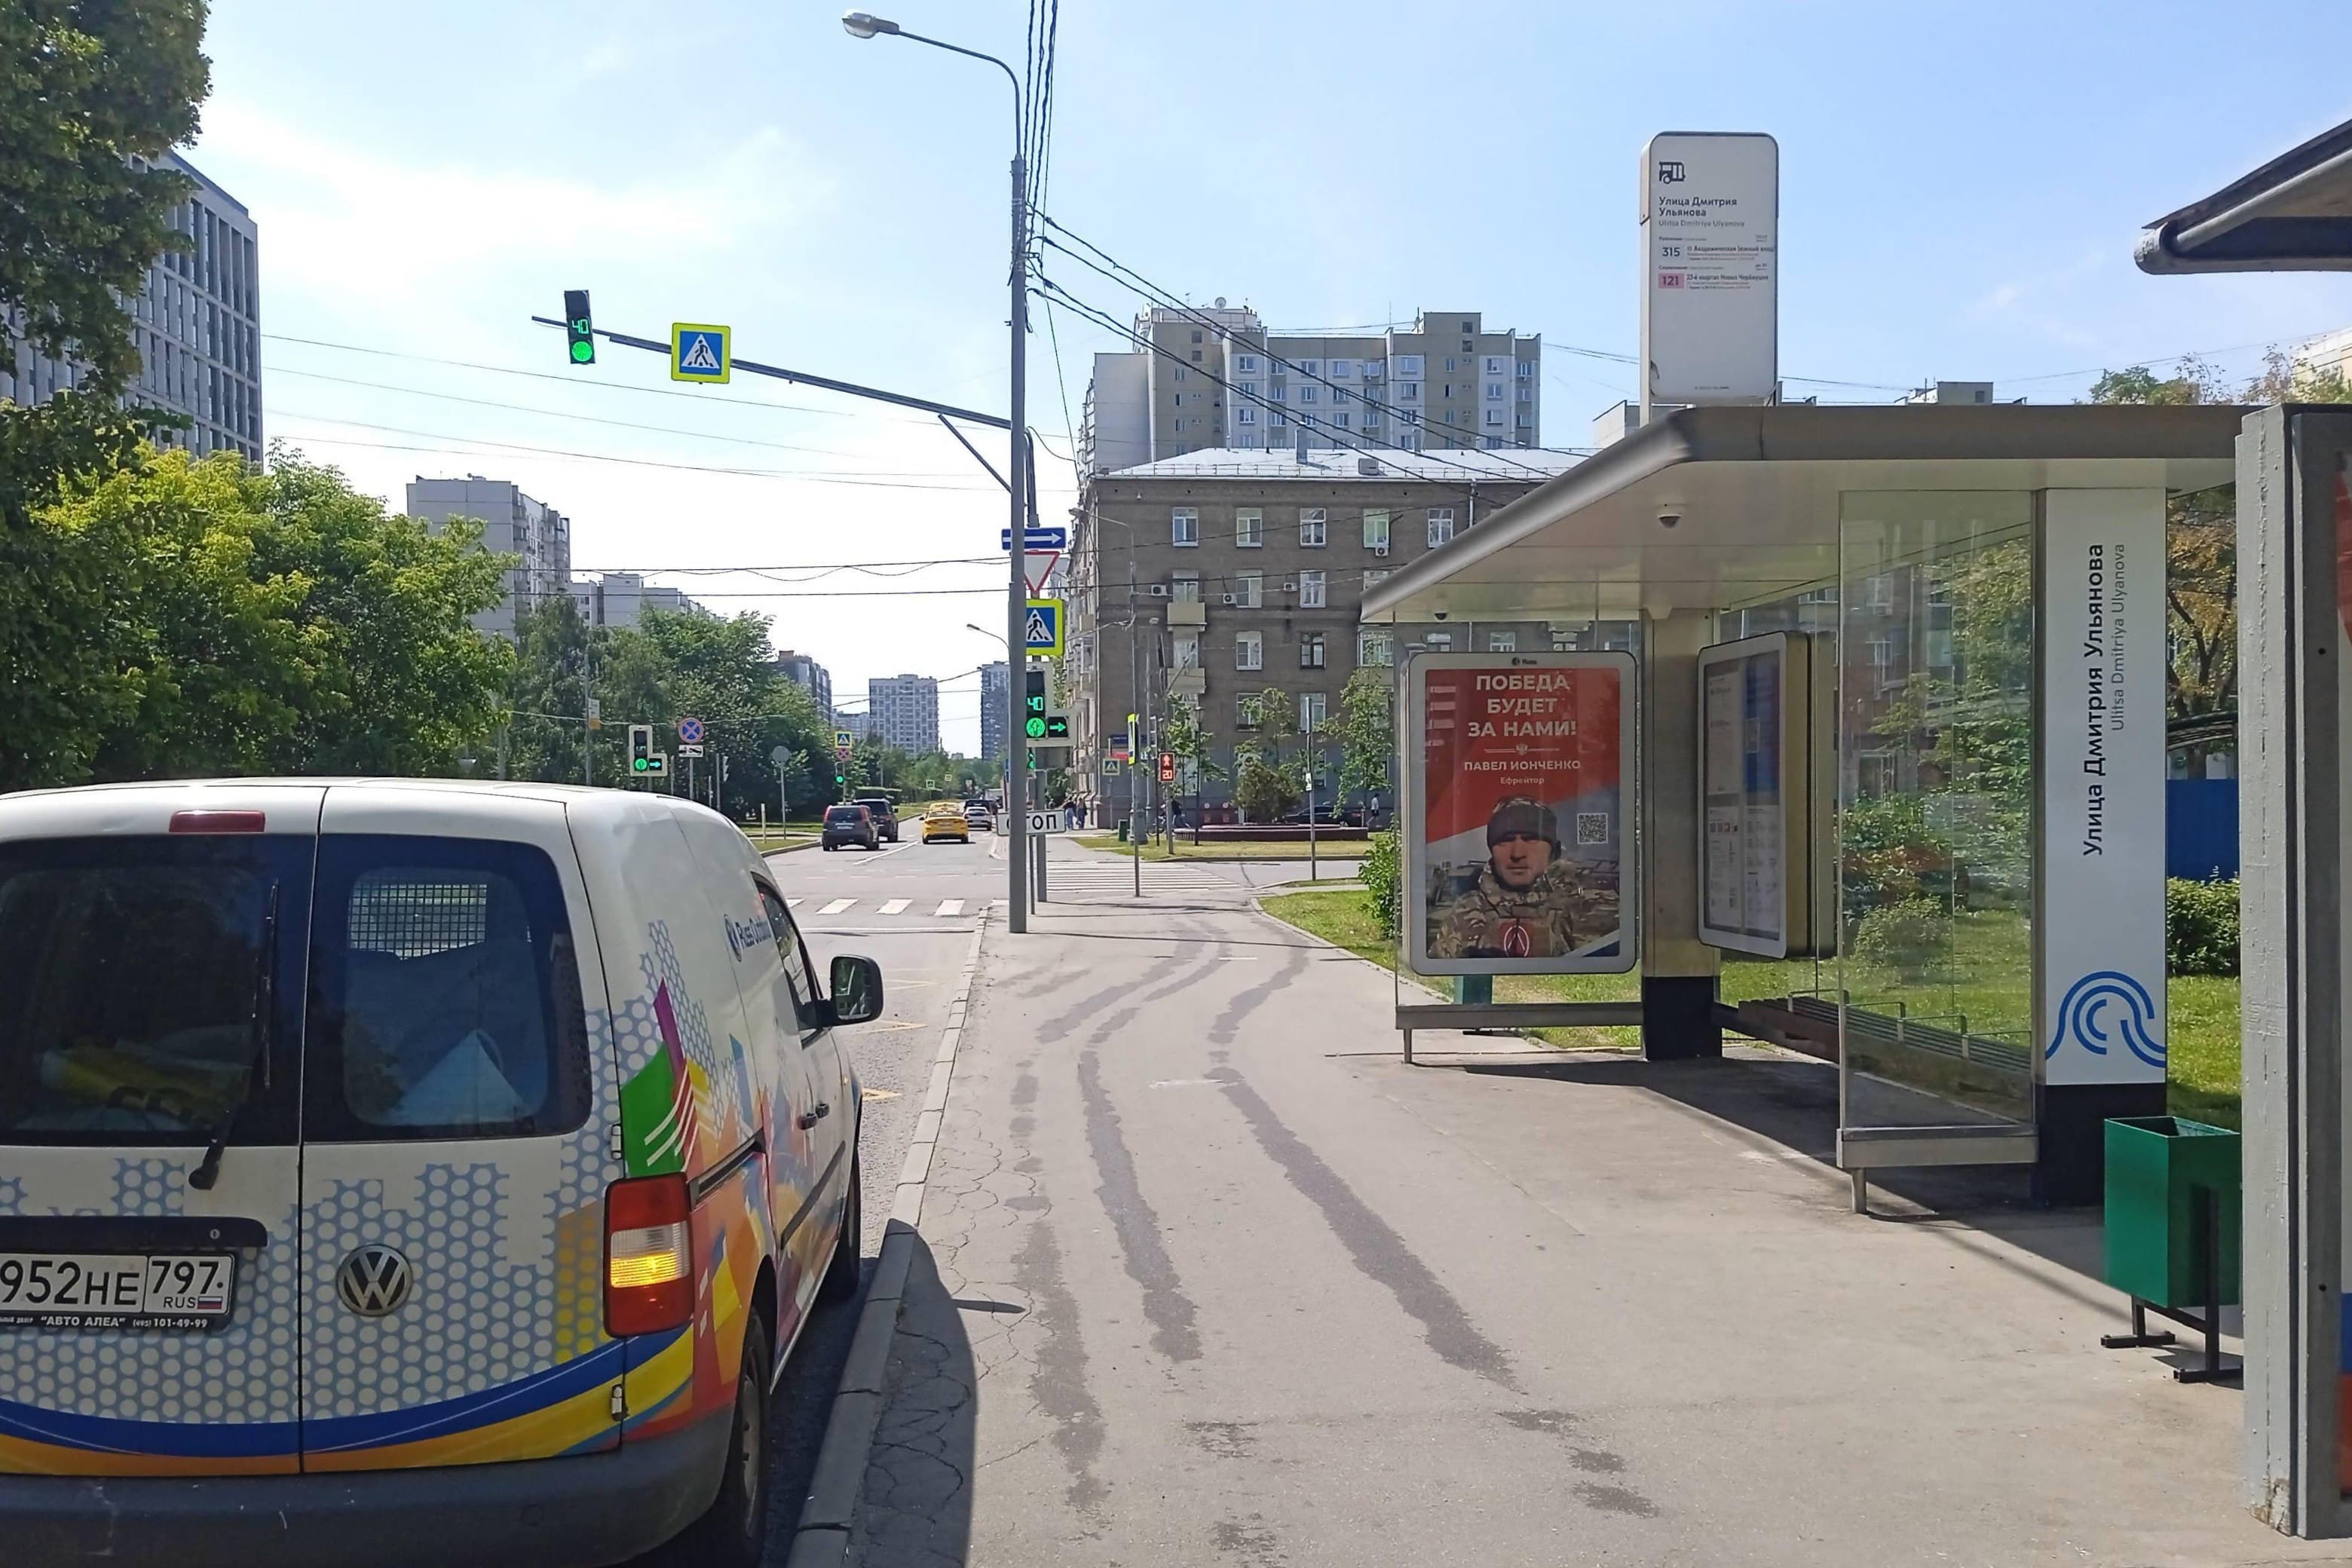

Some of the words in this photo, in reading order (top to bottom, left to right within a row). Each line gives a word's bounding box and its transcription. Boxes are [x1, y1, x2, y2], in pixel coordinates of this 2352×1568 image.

[1658, 196, 1689, 206] Улица
[1692, 197, 1737, 207] Дмитрия
[1658, 207, 1706, 216] Ульянова
[1662, 247, 1680, 257] 315
[1663, 276, 1679, 286] 121
[571, 319, 590, 334] 40
[2111, 544, 2127, 613] Ulyanova
[2084, 544, 2103, 657] Ульянова
[2111, 618, 2127, 684] Dmitriya
[1476, 675, 1570, 692] ПОБЕДА
[1027, 697, 1044, 711] 40
[1487, 698, 1557, 715] БУДЕТ
[2111, 689, 2124, 730] Ulitsa
[1468, 721, 1496, 737] ЗА
[1503, 721, 1576, 737] НАМИ!
[2084, 668, 2106, 776] Дмитрия
[1464, 761, 1507, 770] ПАВЕЛ
[1510, 761, 1581, 770] ИОНЧЕНКО
[1162, 770, 1173, 779] 20
[1500, 776, 1545, 786] Ефрейтор
[2084, 785, 2105, 856] Улица
[152, 1260, 219, 1295] 797
[163, 1297, 196, 1308] RUS
[154, 1318, 207, 1328] 101-49-99
